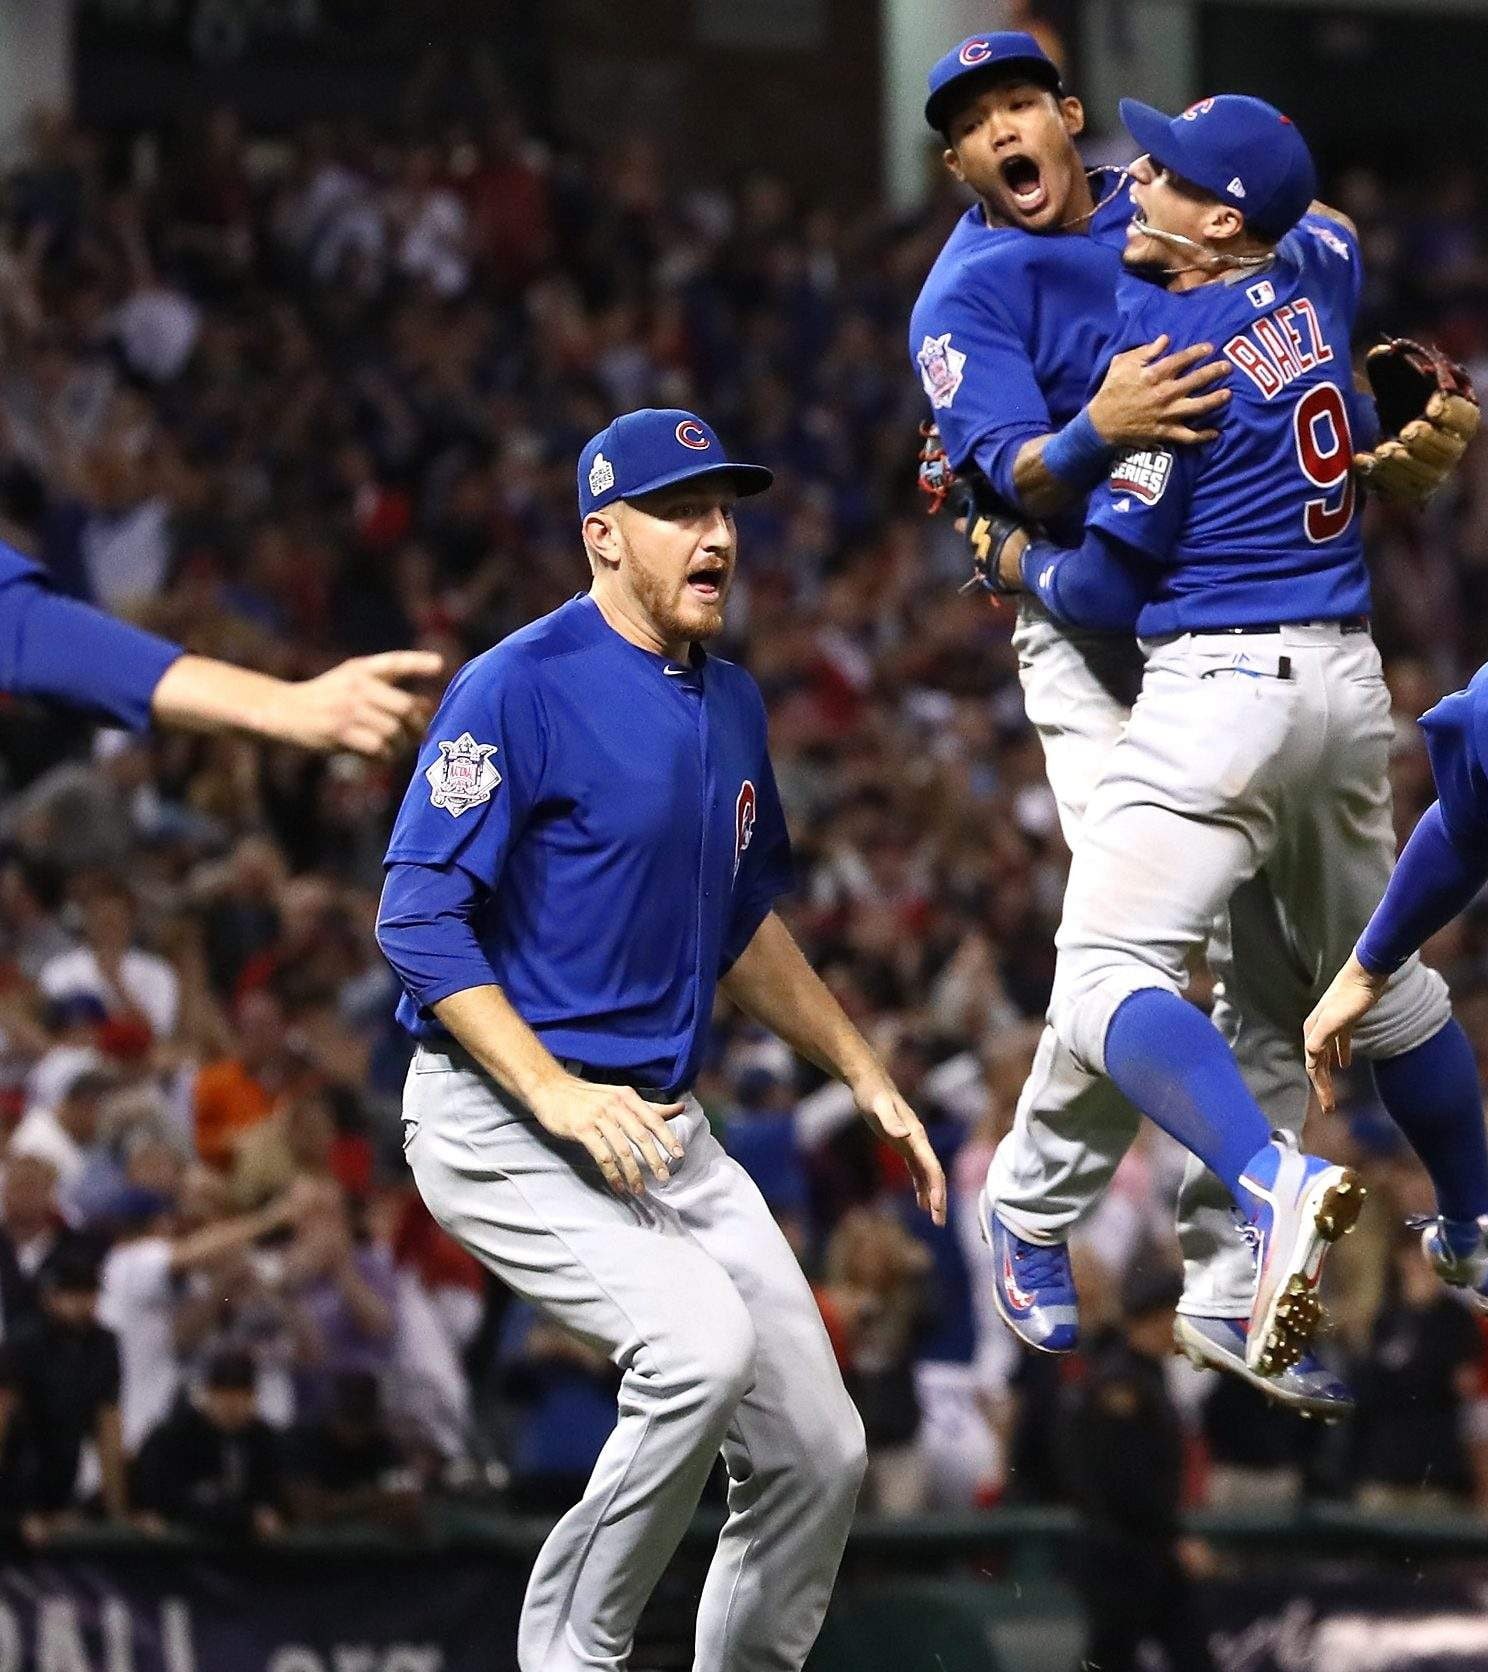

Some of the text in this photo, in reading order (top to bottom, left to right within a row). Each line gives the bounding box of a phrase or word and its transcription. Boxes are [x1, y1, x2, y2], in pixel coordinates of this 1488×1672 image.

[1223, 297, 1334, 401] BAEZ
[675, 420, 711, 451] C
[1293, 381, 1356, 544] 9
